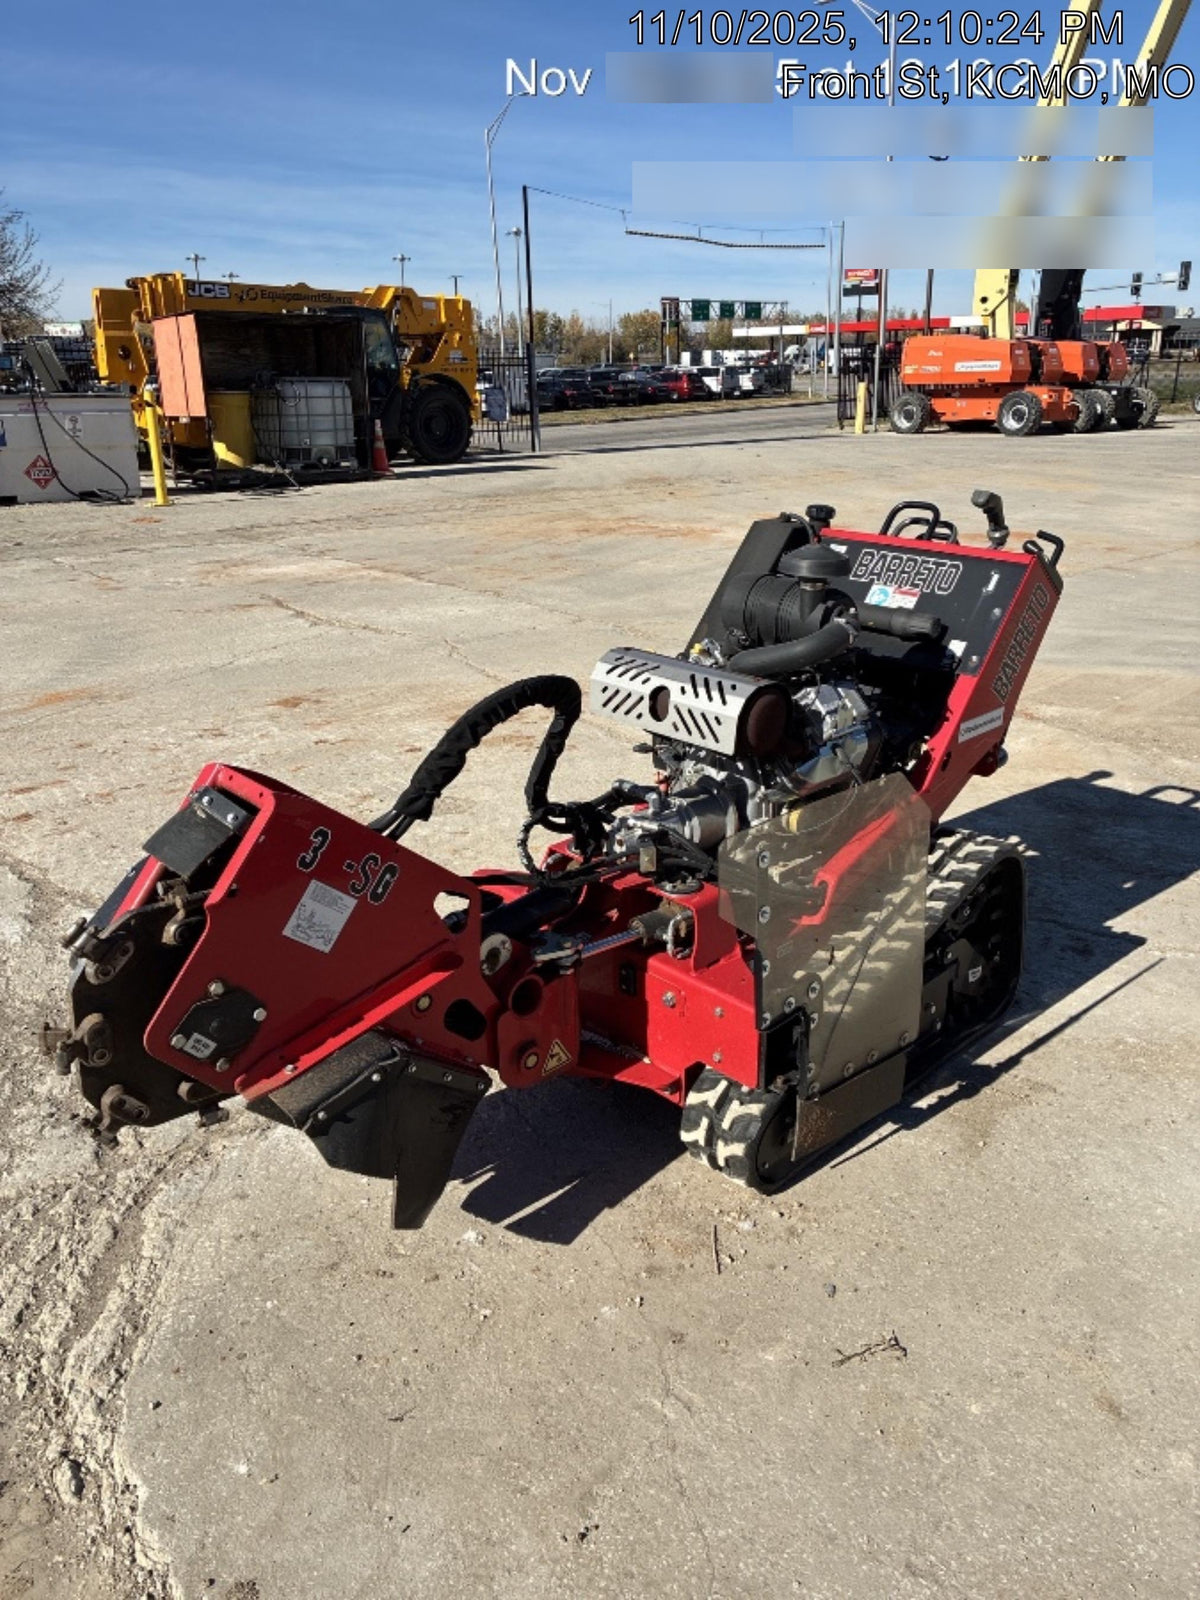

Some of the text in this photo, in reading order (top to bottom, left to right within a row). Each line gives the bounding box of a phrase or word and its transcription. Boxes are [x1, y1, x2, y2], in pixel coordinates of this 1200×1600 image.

[188, 283, 230, 298] JCB
[849, 548, 963, 595] BARRETO
[991, 582, 1050, 704] BARRETO
[296, 826, 332, 872] 3
